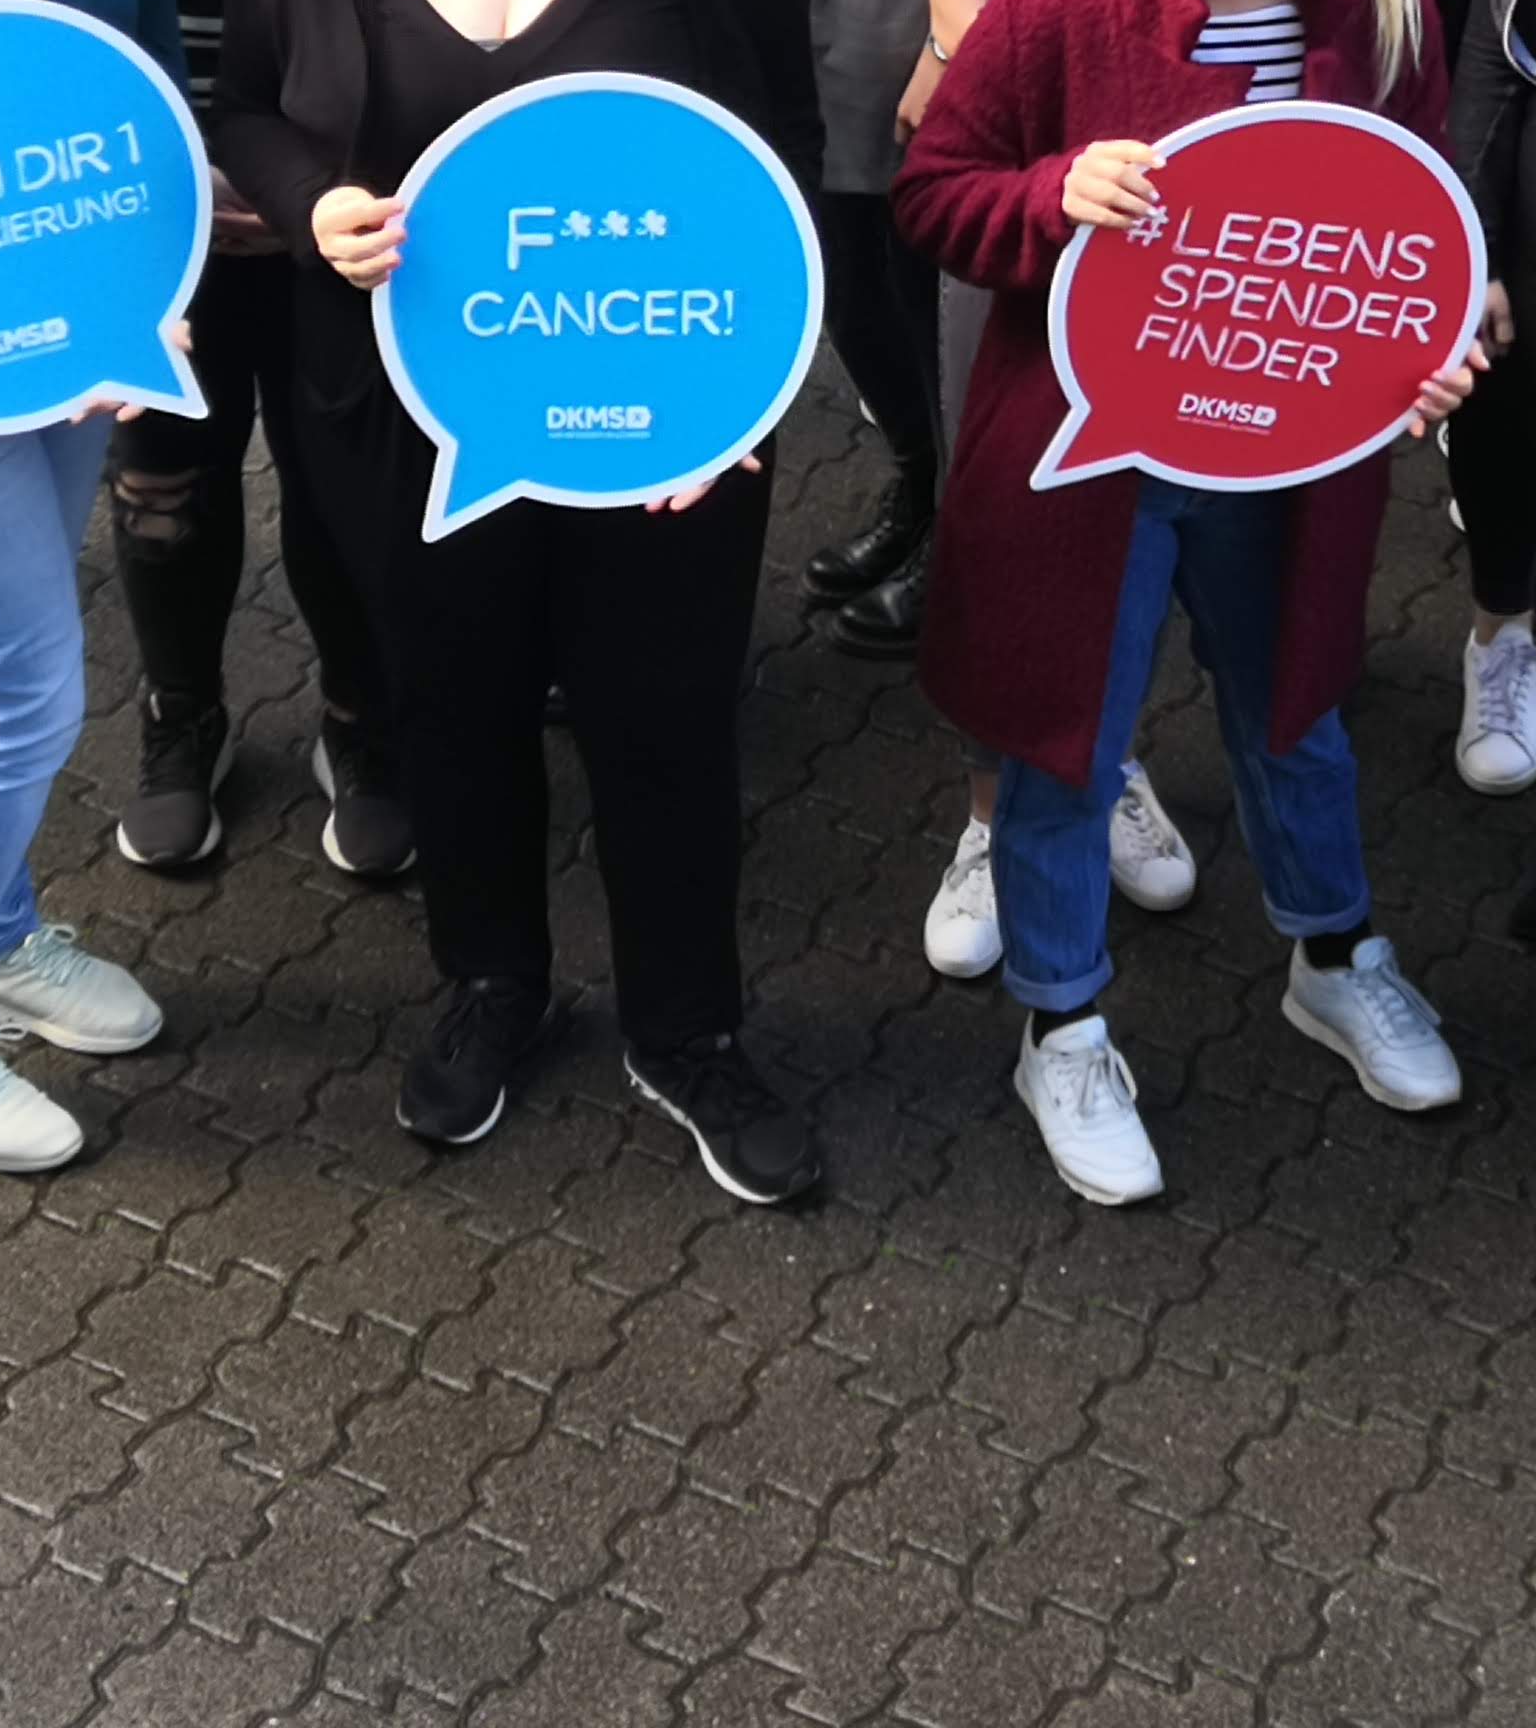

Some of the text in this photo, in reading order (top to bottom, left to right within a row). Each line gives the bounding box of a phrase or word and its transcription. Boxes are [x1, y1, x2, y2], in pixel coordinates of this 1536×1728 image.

[15, 131, 111, 193] DIR
[116, 121, 142, 165] 1
[463, 289, 735, 336] CANCER!
[1154, 263, 1437, 343] SPENDER
[1135, 314, 1339, 386] FINDER
[547, 405, 624, 429] DKMS
[1178, 392, 1254, 424] DKMS
